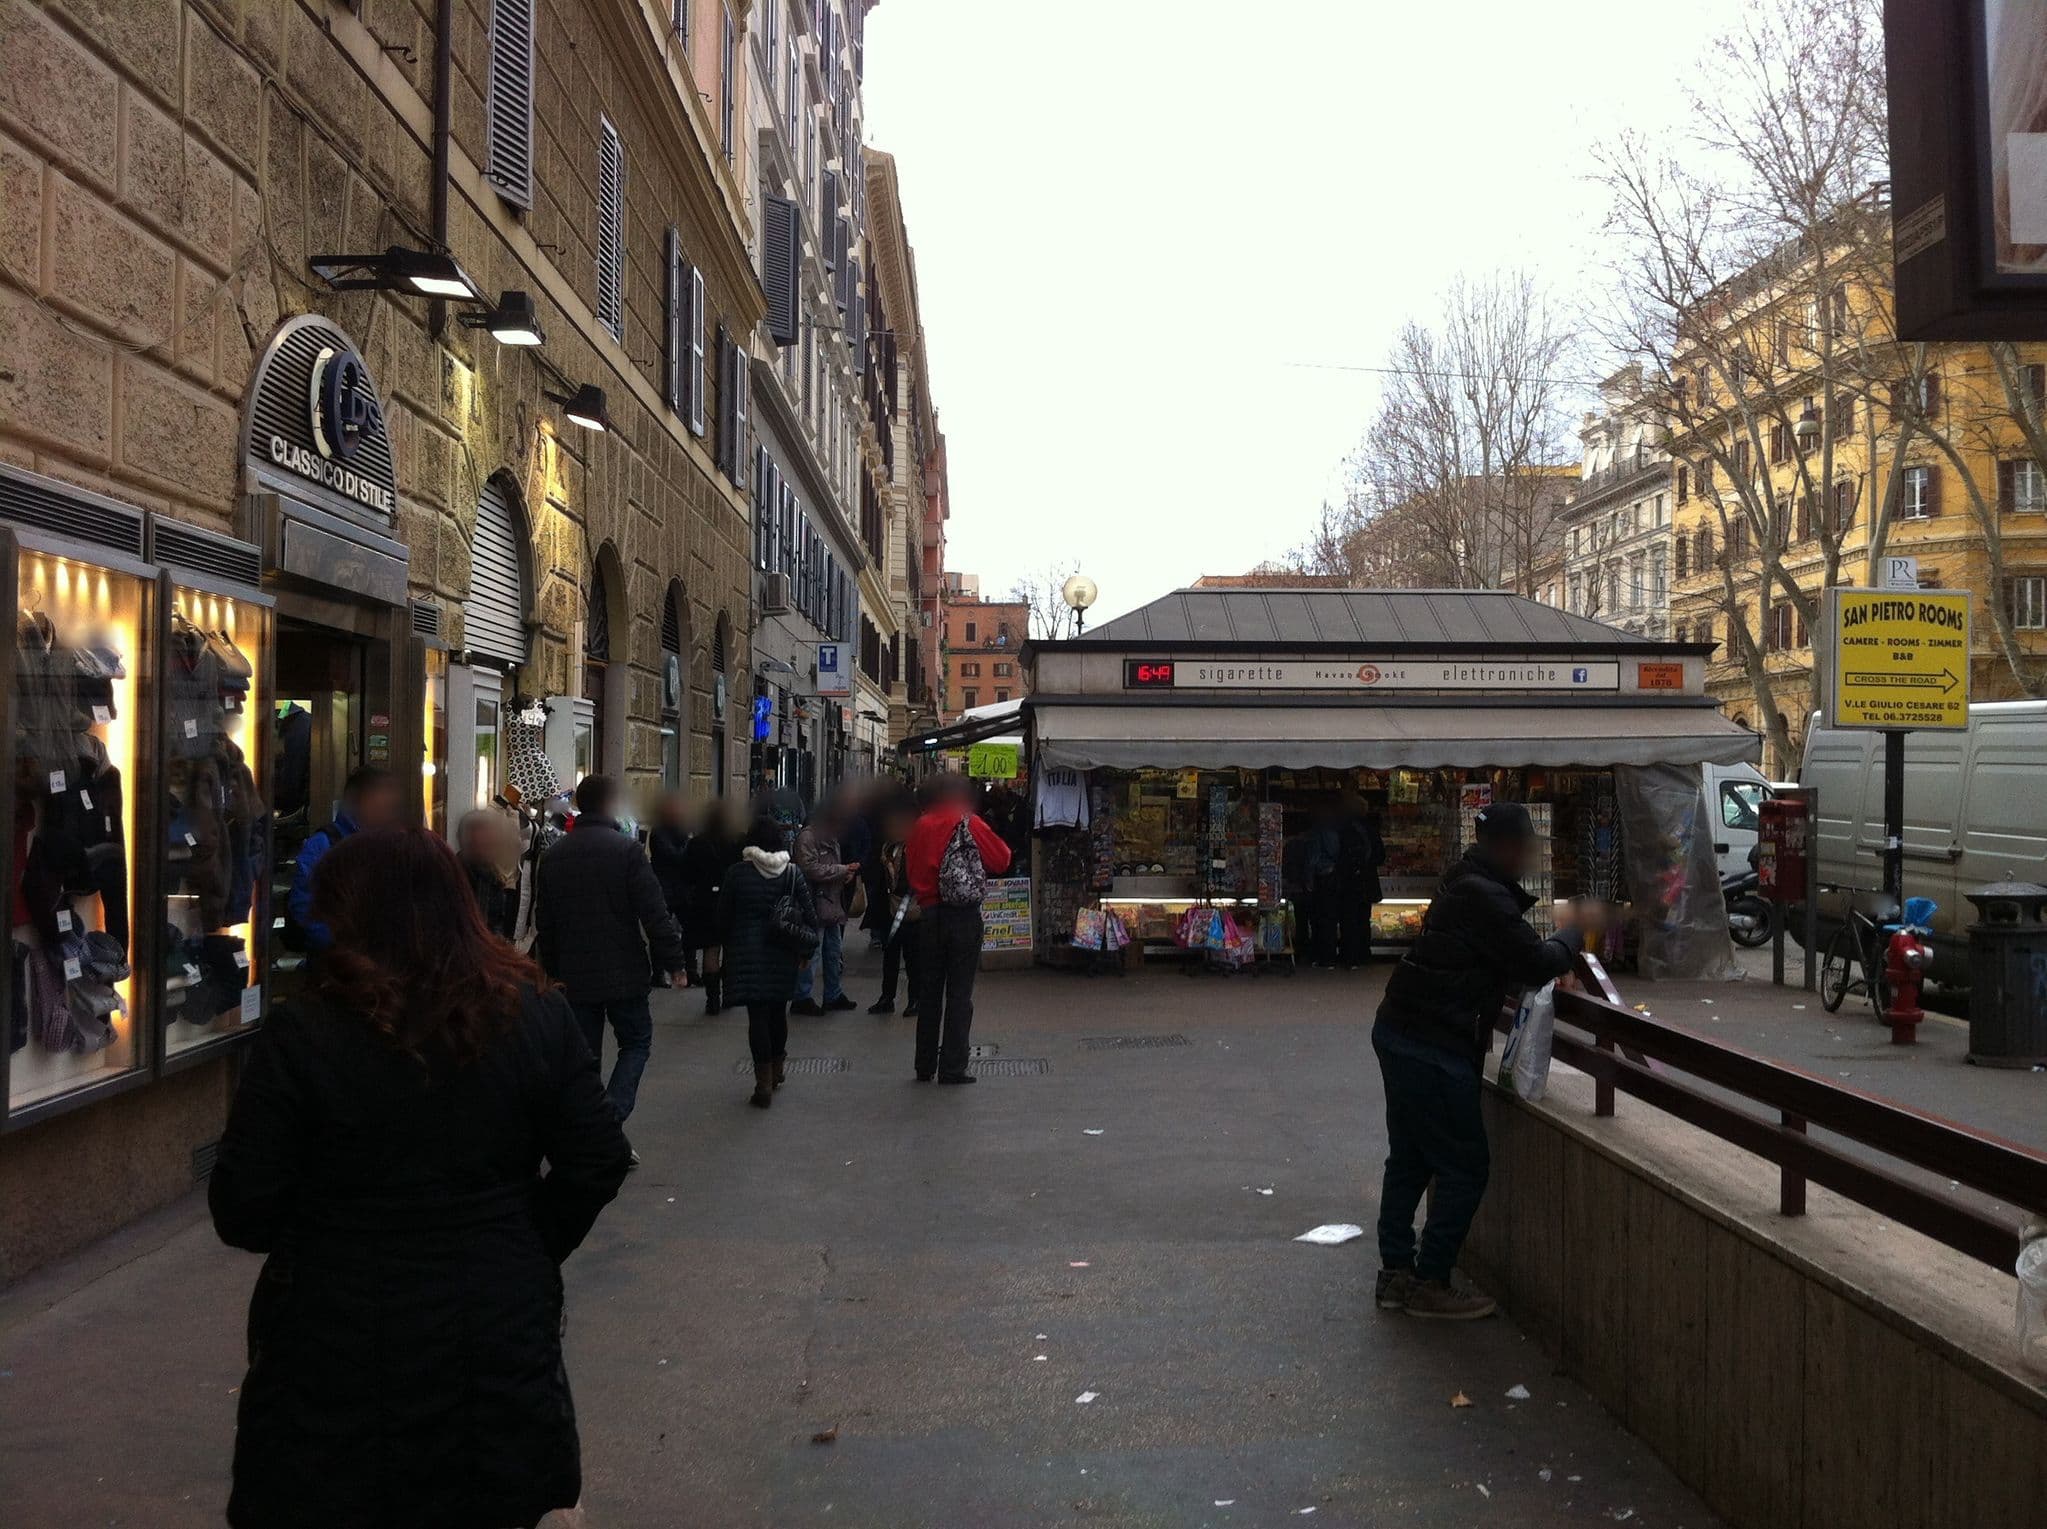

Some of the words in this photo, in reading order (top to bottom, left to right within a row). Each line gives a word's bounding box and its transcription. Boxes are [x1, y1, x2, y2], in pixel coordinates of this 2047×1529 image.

[270, 435, 344, 490] CLASSICO
[345, 473, 359, 497] DI
[359, 482, 392, 514] STILE
[1843, 604, 1868, 629] SAN
[1871, 601, 1916, 623] PIETRO
[1919, 603, 1963, 631] ROOMS
[1843, 637, 1879, 647] CAMERE
[1887, 638, 1920, 648] ROOMS
[1928, 639, 1963, 648] ZIMMER
[821, 647, 836, 666] T
[1892, 652, 1914, 661] B&B
[1137, 664, 1170, 682] 16:49
[1199, 667, 1283, 683] sigarette
[1443, 665, 1557, 682] elettroniche
[1854, 675, 1888, 684] CROSS
[1889, 676, 1907, 684] THE
[1910, 676, 1937, 685] ROAD
[1844, 700, 1866, 709] V.LE
[1869, 700, 1904, 710] GIULIO
[1906, 701, 1945, 710] CESARE
[1862, 711, 1881, 721] TEL
[1047, 771, 1078, 787] ITALIA
[984, 925, 1012, 936] Enel
